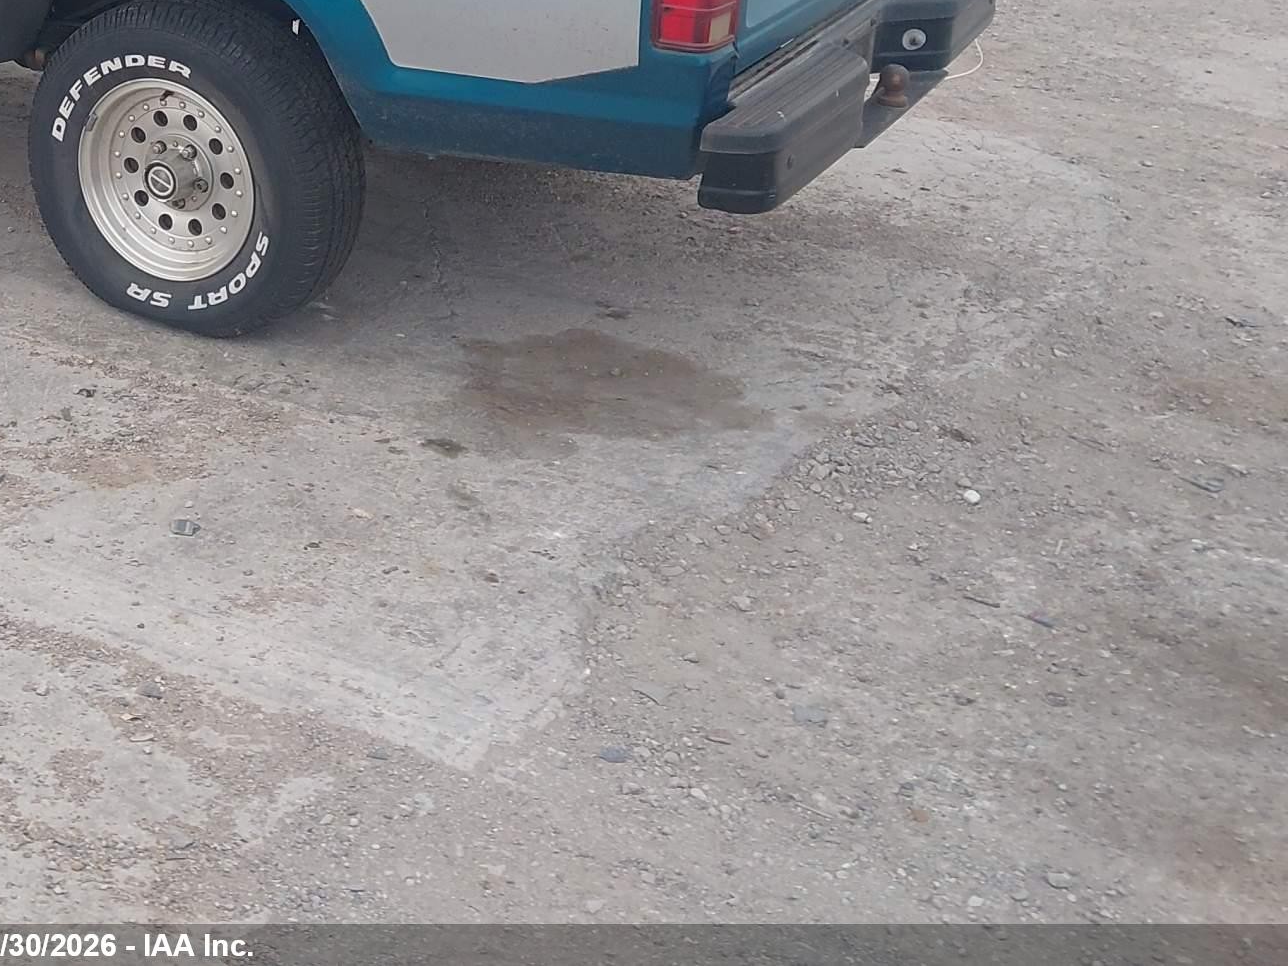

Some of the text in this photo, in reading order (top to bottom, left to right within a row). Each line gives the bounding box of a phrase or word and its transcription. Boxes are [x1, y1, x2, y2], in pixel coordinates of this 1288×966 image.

[51, 54, 192, 142] DEFENDER
[126, 231, 269, 310] SPORT SR
